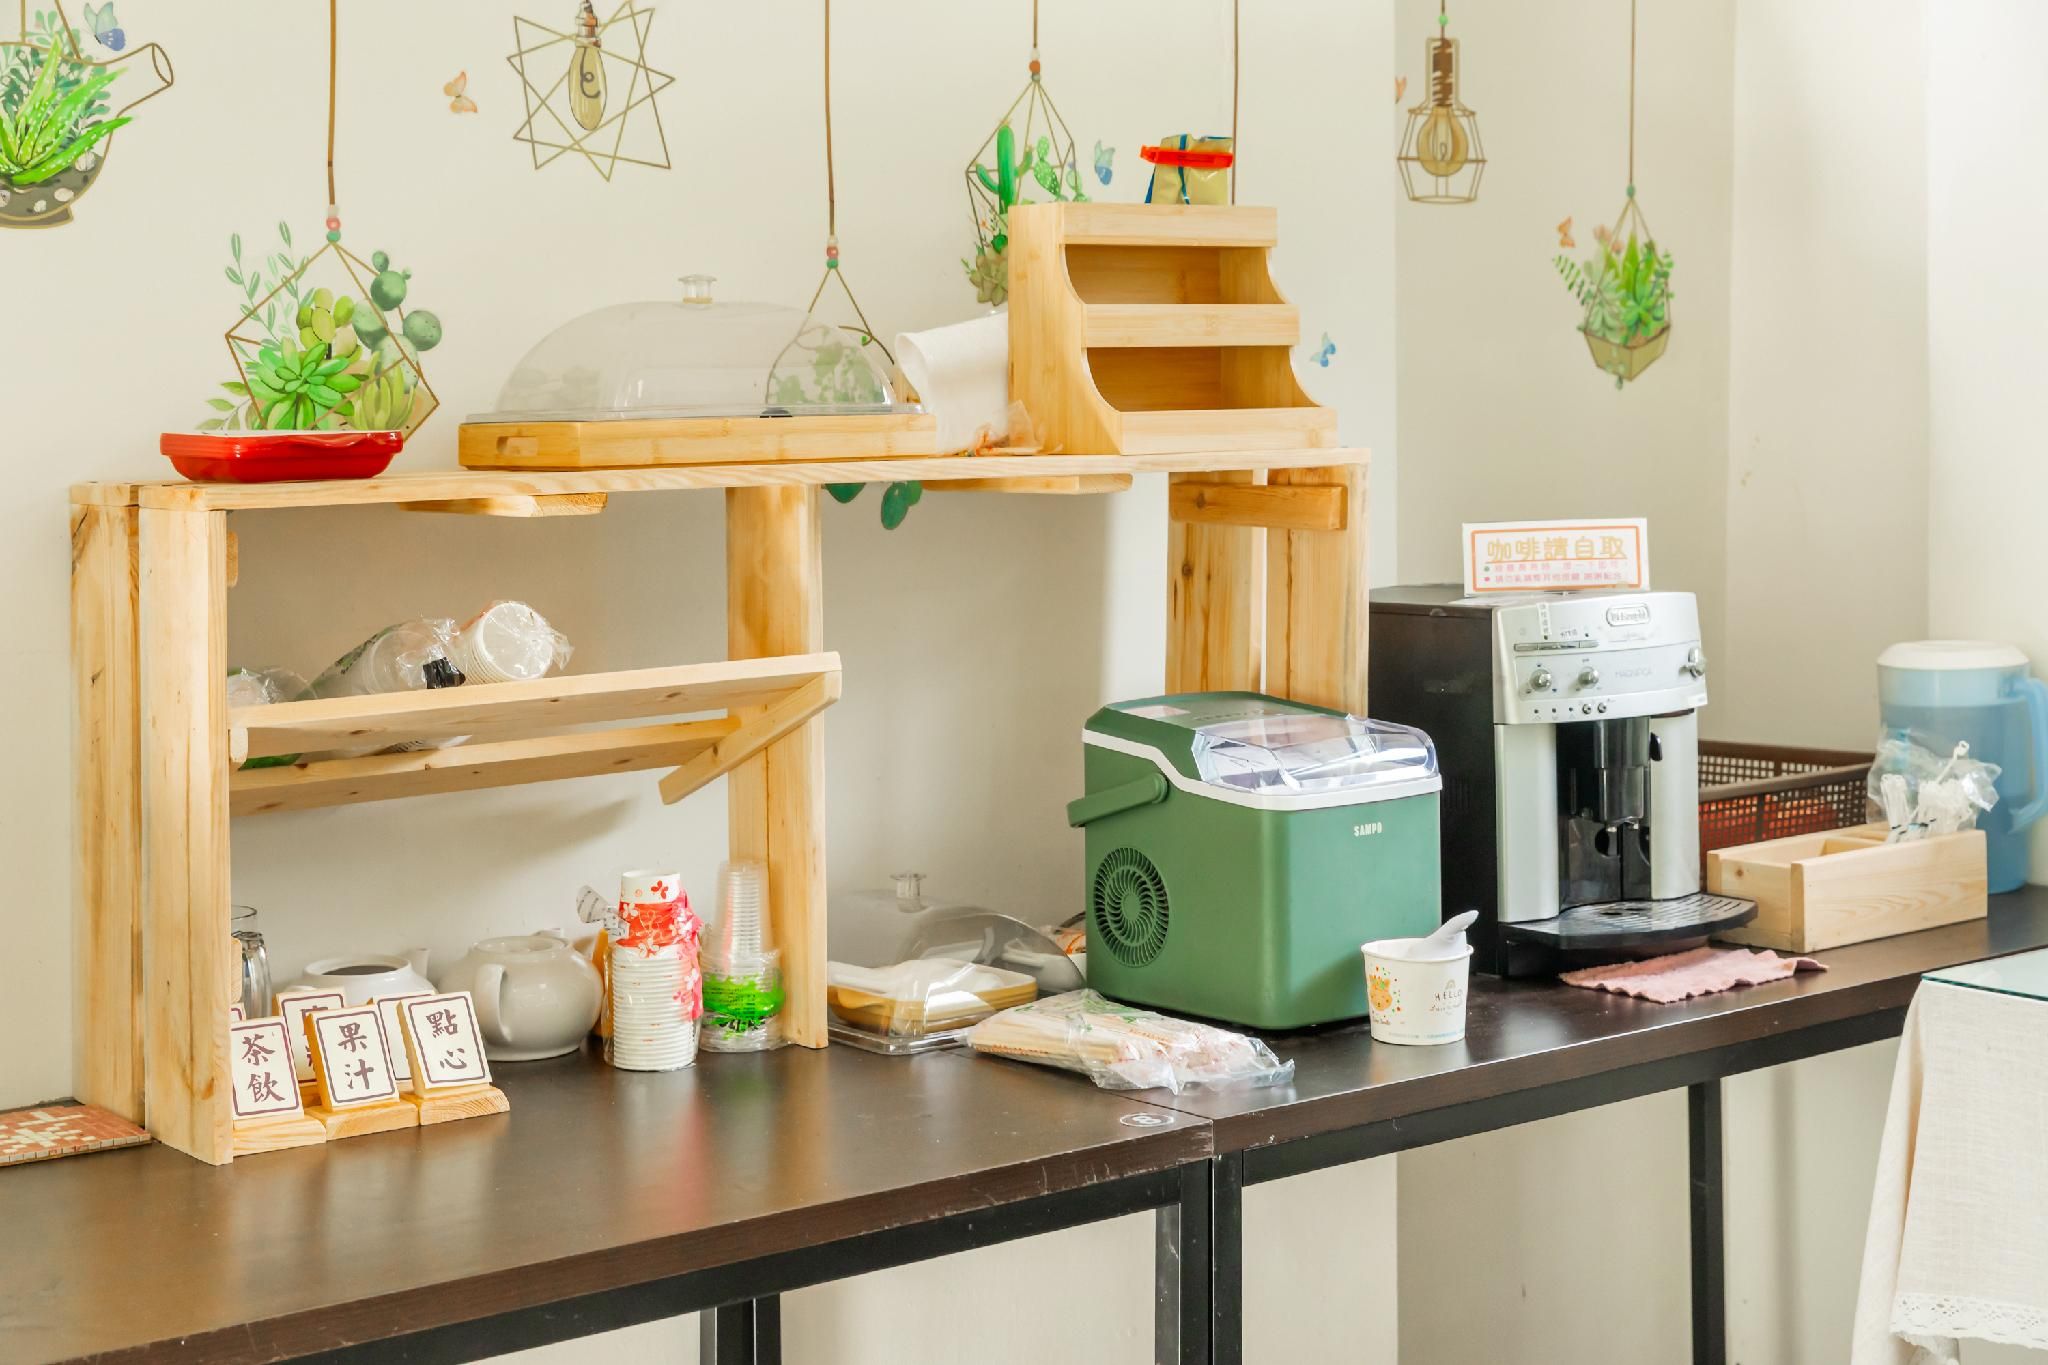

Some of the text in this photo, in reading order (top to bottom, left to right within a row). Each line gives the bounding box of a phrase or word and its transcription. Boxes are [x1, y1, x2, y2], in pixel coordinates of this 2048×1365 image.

[1487, 535, 1626, 561] 咖啡請自取
[1353, 821, 1383, 837] SAMPO
[241, 1033, 286, 1103] 茶飲
[338, 1022, 375, 1090] 果汁
[425, 1008, 468, 1070] 點心
